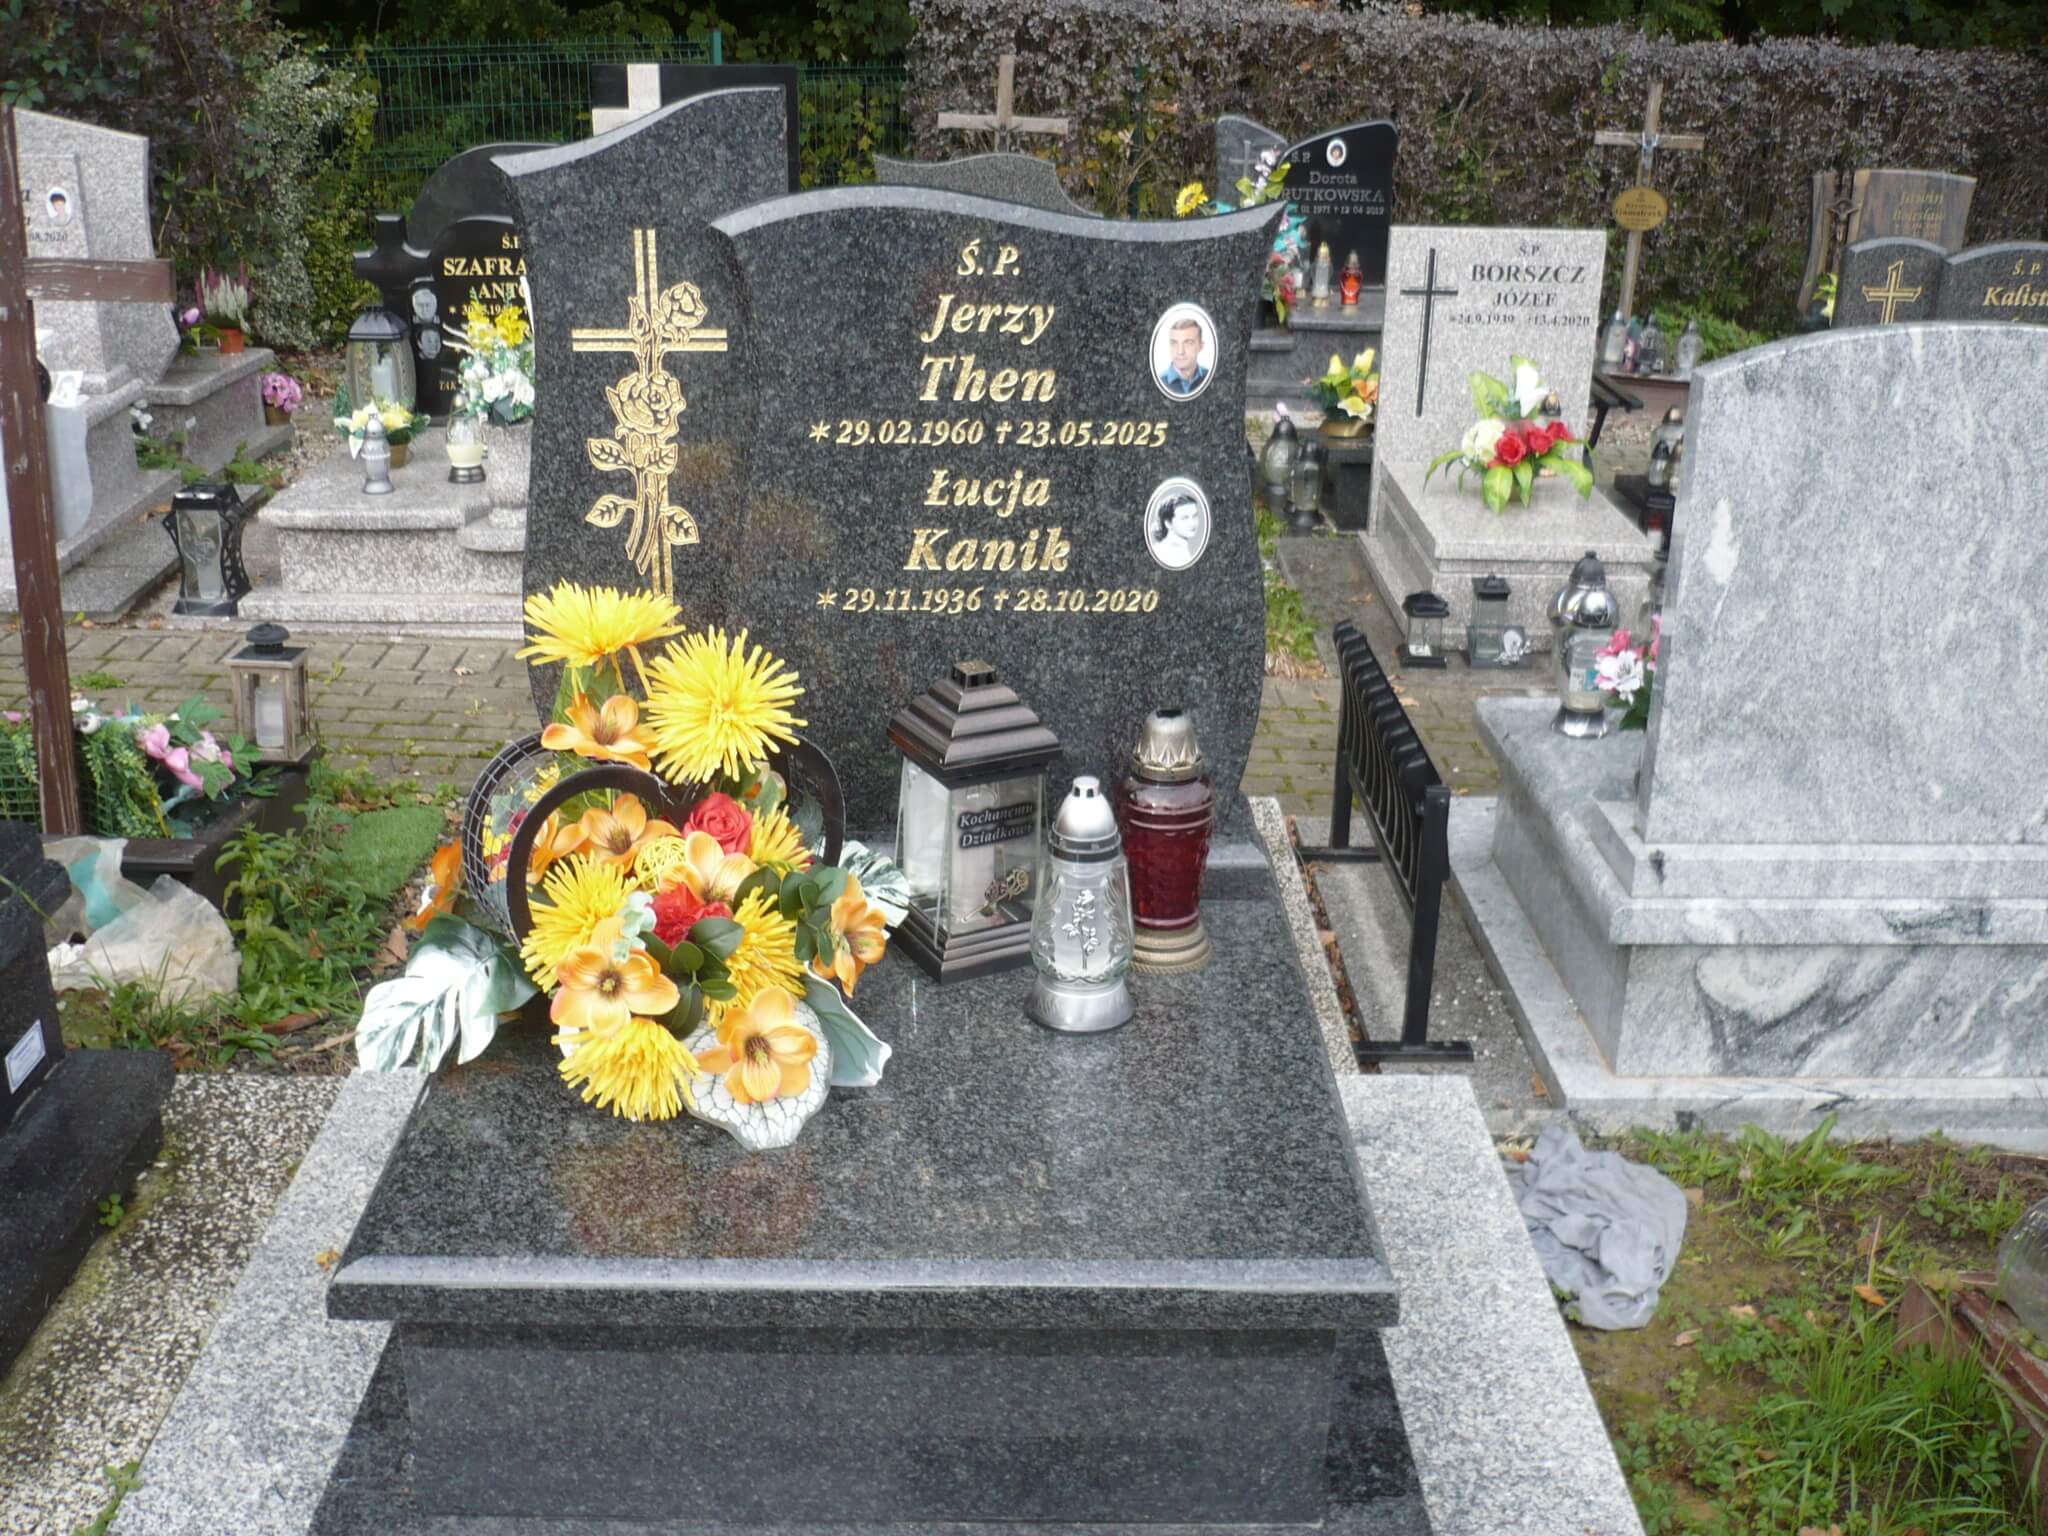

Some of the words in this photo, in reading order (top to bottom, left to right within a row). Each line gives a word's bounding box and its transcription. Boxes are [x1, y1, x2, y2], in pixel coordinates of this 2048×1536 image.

[1309, 171, 1358, 185] Dorota
[1282, 187, 1385, 203] RUTKOWSKA
[1472, 264, 1586, 284] BORSZCZ
[1493, 288, 1558, 307] JÓZEF
[920, 293, 1055, 345] Jerzy
[919, 354, 1057, 403] Then
[836, 420, 985, 447] 29.02.1960
[1016, 420, 1169, 448] 23.05.2025
[924, 468, 1052, 517] Łucja
[903, 527, 1072, 572] Kanik
[842, 587, 984, 614] 29.11.1936
[1013, 588, 1159, 613] 28.10.2020
[960, 804, 1033, 828] Kochanemu
